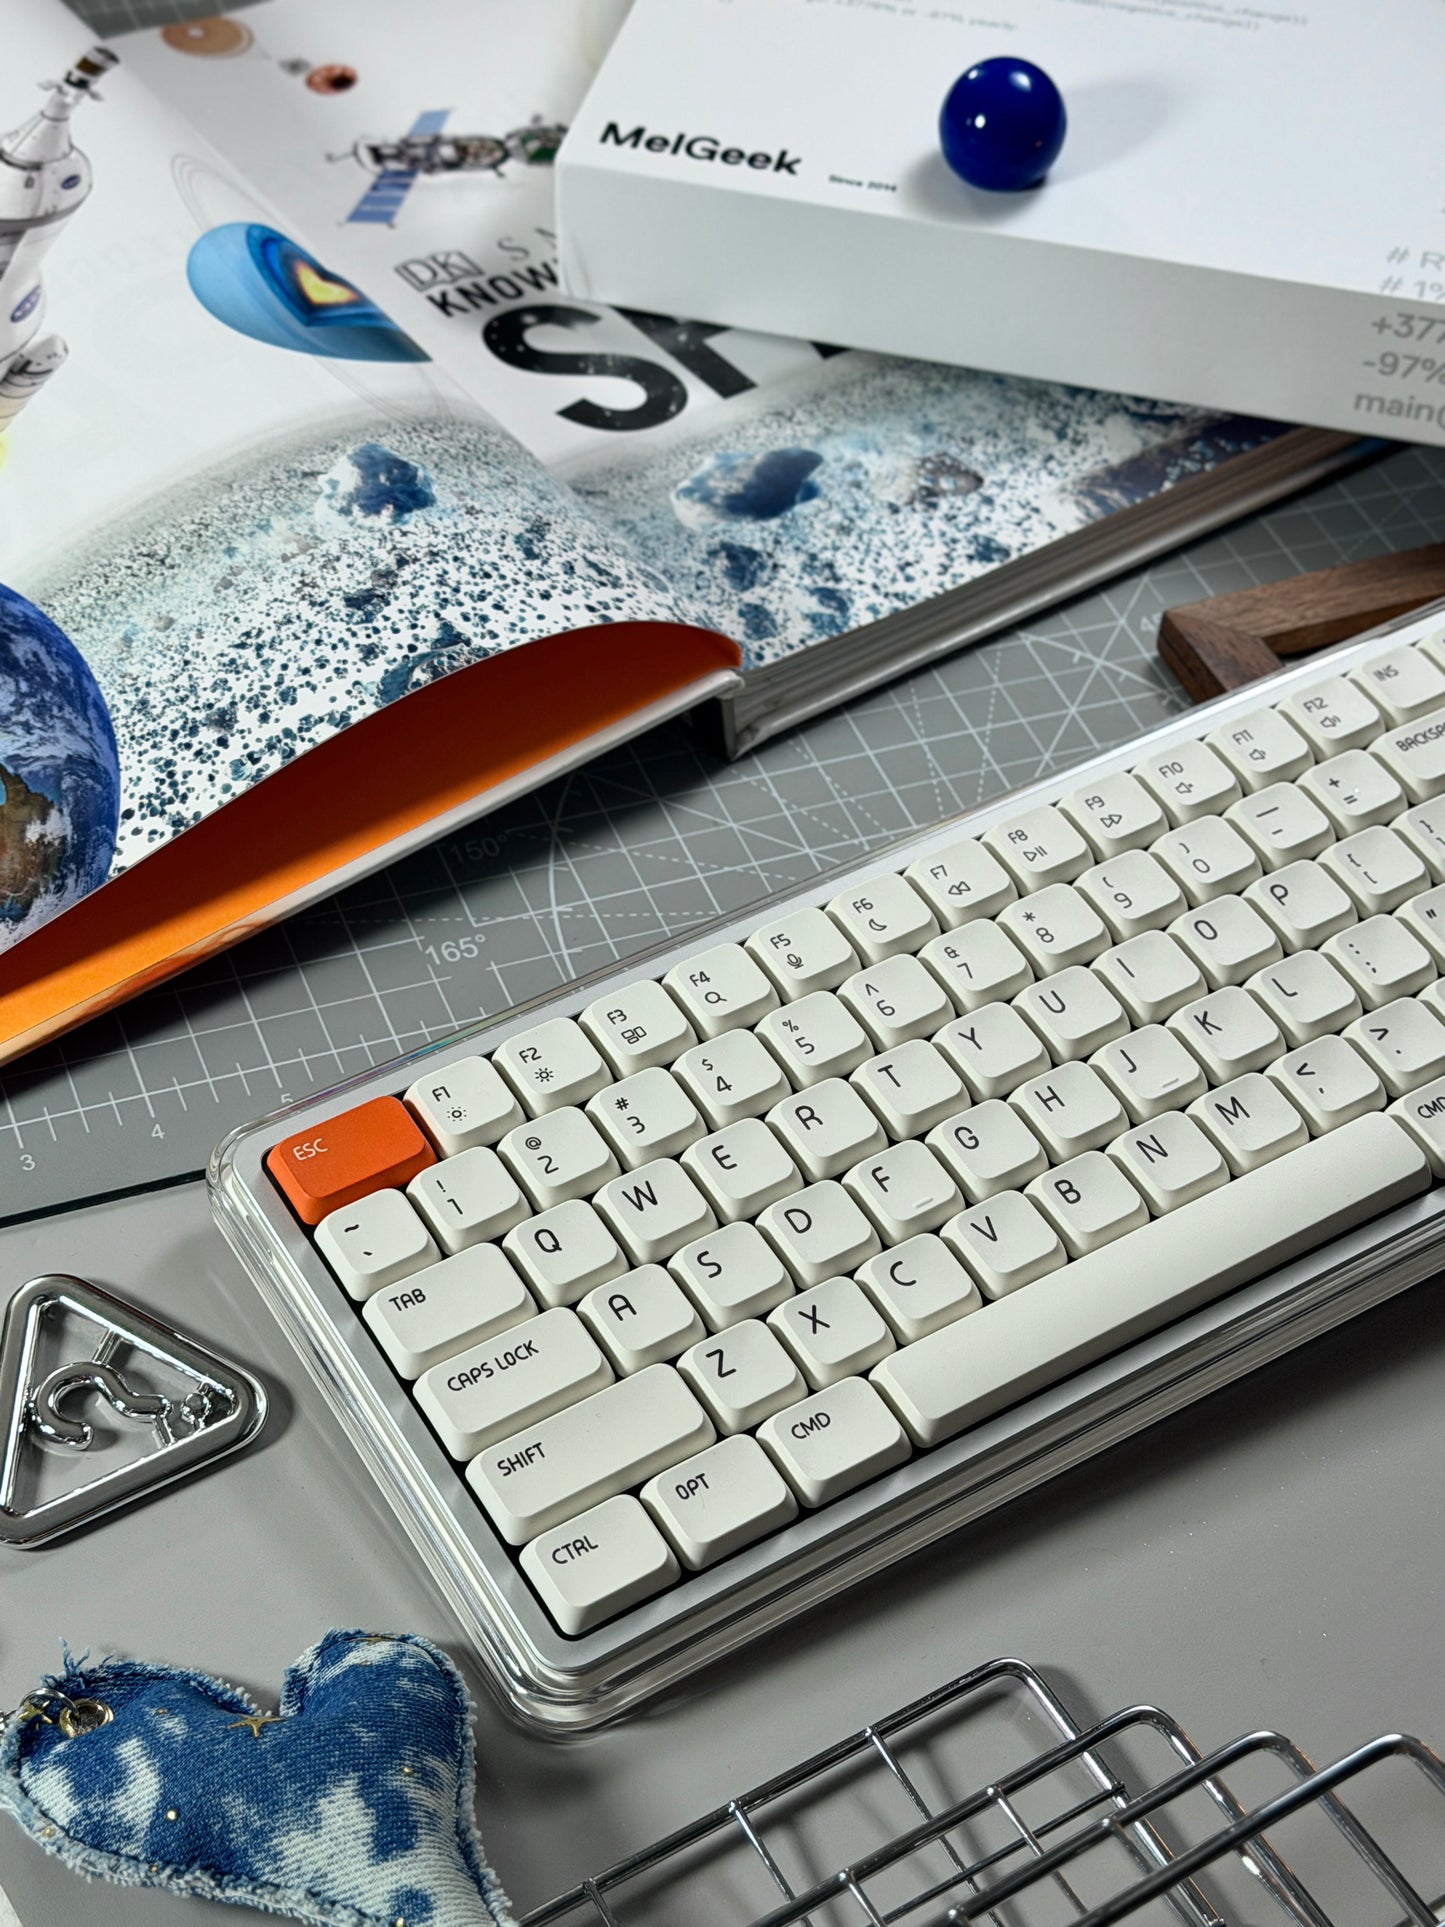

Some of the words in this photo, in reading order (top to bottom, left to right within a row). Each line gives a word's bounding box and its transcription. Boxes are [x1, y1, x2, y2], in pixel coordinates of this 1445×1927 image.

[599, 121, 803, 176] MelGeek
[396, 251, 483, 292] DK
[426, 258, 558, 318] KNOW
[1363, 350, 1445, 386] -97%
[1373, 665, 1399, 682] INS
[1303, 696, 1329, 714] F12
[1232, 729, 1254, 746] F11
[1395, 722, 1445, 752] BACKSP
[1158, 761, 1184, 779] F10
[1084, 795, 1106, 811] F9
[1007, 828, 1029, 845] F8
[930, 864, 948, 881] F7
[852, 897, 874, 914] F6
[1113, 892, 1133, 910] 9
[1269, 883, 1289, 907] P
[769, 933, 792, 950] F5
[1035, 927, 1055, 944] 8
[1193, 919, 1218, 941] O
[689, 970, 711, 987] F4
[957, 962, 974, 980] 7
[1271, 977, 1298, 998] L
[876, 1000, 896, 1017] 6
[1038, 990, 1066, 1014] U
[606, 1008, 628, 1026] F3
[1193, 1010, 1223, 1036] K
[795, 1036, 816, 1055] 5
[958, 1027, 983, 1051] Y
[519, 1047, 542, 1064] F2
[1119, 1049, 1138, 1074] J
[716, 1075, 733, 1093] 4
[877, 1064, 902, 1089] T
[432, 1085, 451, 1102] F1
[1034, 1085, 1066, 1112] H
[794, 1105, 824, 1131] R
[1214, 1096, 1251, 1126] M
[1417, 1095, 1445, 1119] CMD
[151, 1124, 166, 1140] 4
[626, 1116, 646, 1134] 3
[293, 1138, 328, 1161] ESC
[954, 1126, 980, 1150] G
[1135, 1134, 1169, 1164] N
[20, 1154, 36, 1172] 3
[537, 1155, 560, 1175] 2
[711, 1144, 738, 1171] E
[871, 1166, 890, 1193] F
[621, 1180, 658, 1212] W
[1054, 1179, 1082, 1205] B
[447, 1198, 464, 1216] 1
[784, 1208, 812, 1234] D
[970, 1215, 998, 1242] V
[534, 1228, 563, 1254] Q
[697, 1250, 722, 1279] S
[889, 1260, 917, 1287] C
[389, 1288, 427, 1312] TAB
[608, 1293, 638, 1322] A
[798, 1304, 831, 1335] X
[447, 1361, 495, 1392] CAPS
[494, 1339, 540, 1371] LOCK
[705, 1348, 737, 1379] Z
[791, 1412, 831, 1440] CMD
[496, 1441, 546, 1477] SHIFT
[674, 1472, 711, 1502] OPT
[551, 1535, 599, 1565] CTRL
